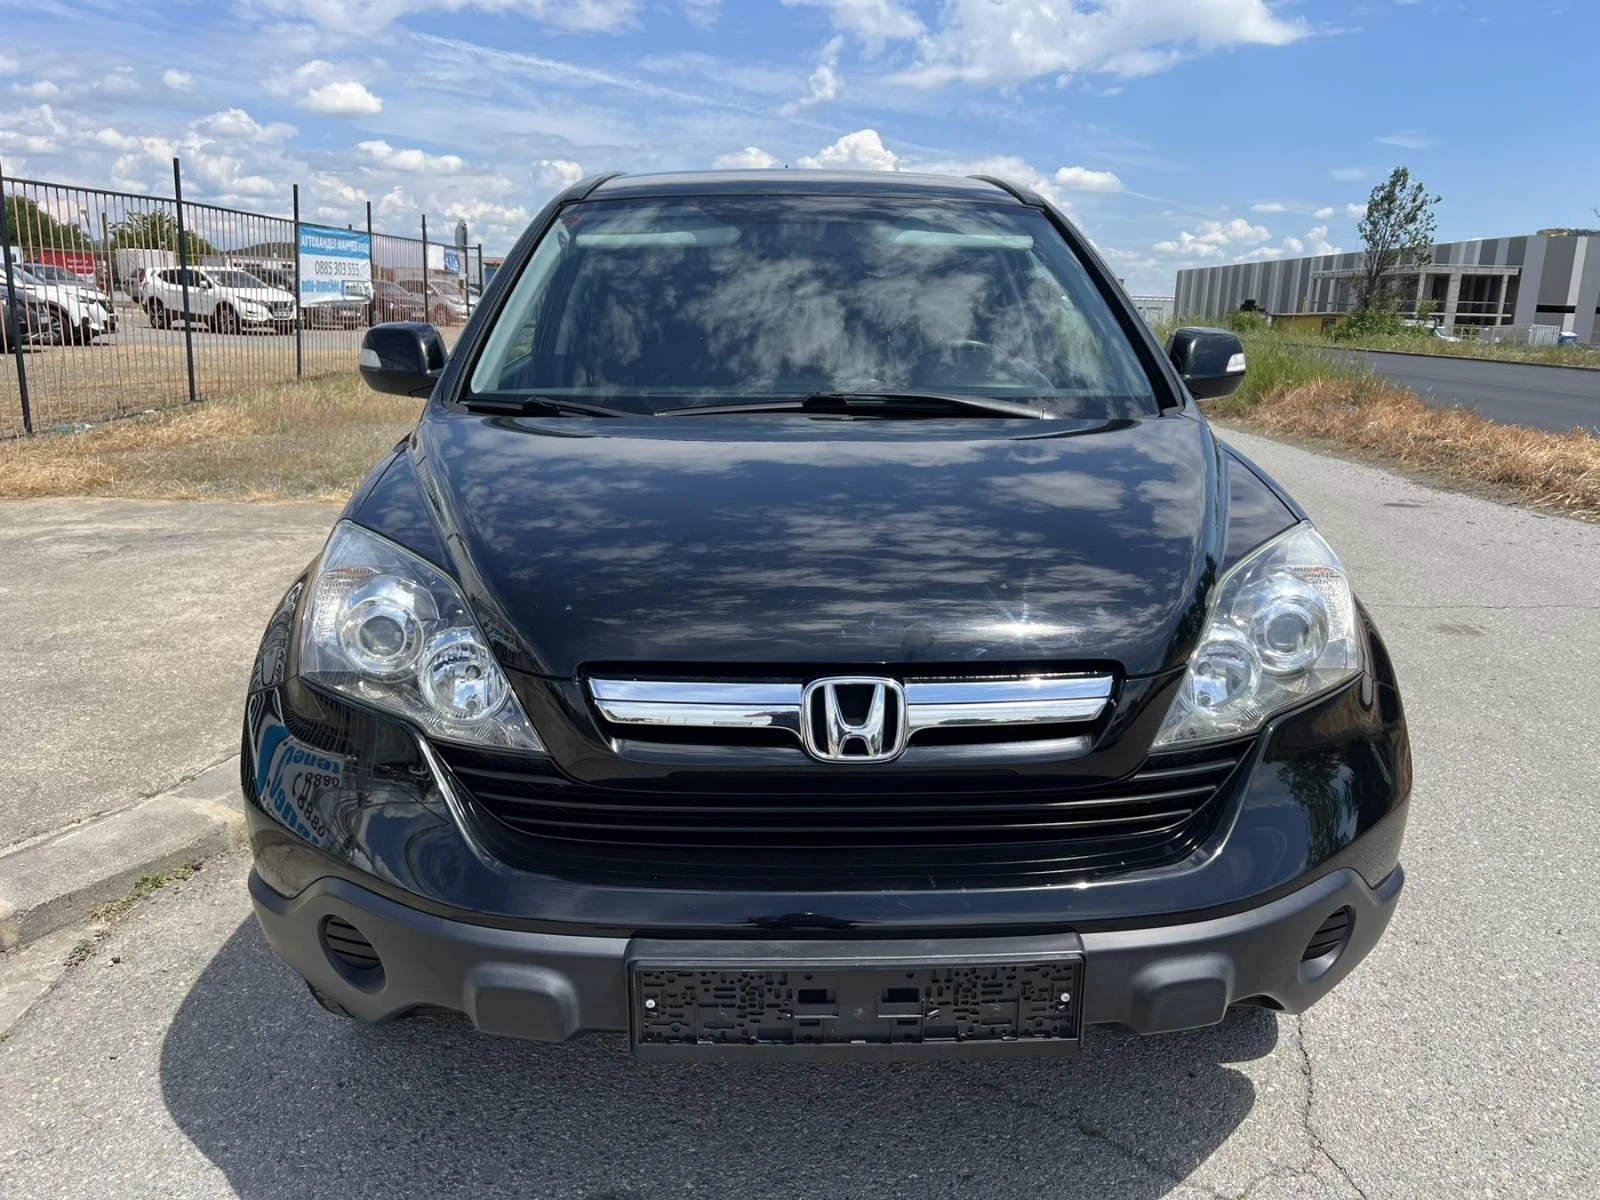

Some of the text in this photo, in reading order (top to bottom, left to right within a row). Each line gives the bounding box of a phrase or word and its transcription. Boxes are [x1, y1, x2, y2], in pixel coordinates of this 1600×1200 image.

[315, 260, 360, 276] 0885 303 555
